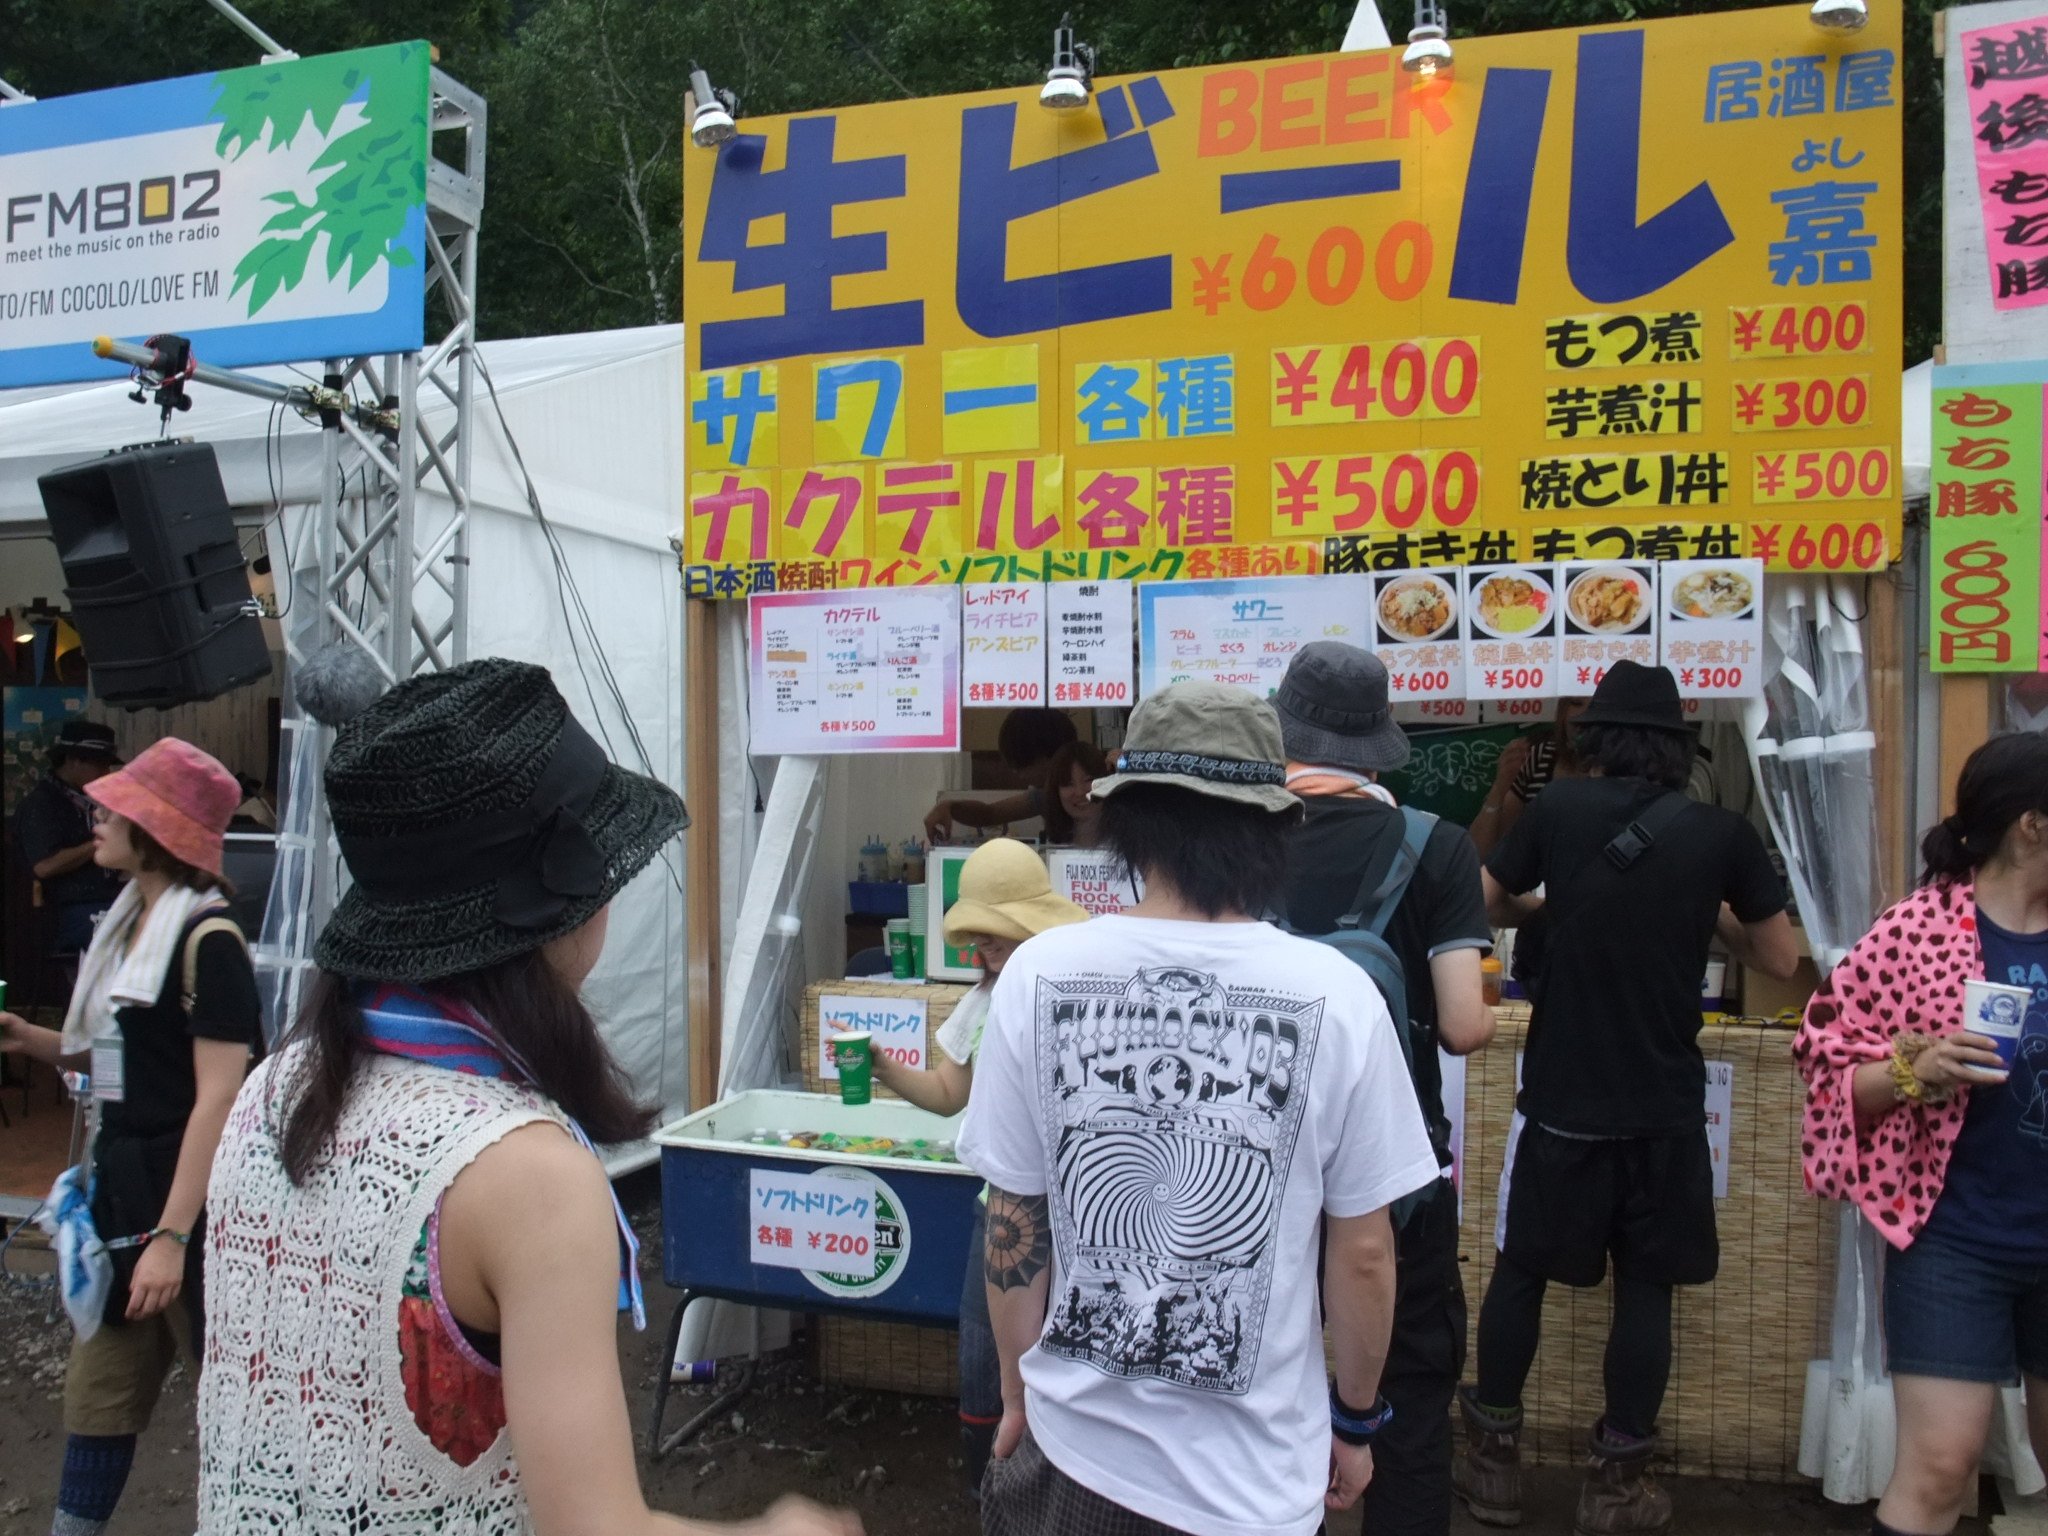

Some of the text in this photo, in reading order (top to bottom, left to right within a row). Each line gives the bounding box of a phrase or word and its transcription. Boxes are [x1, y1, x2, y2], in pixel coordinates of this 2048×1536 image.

[1703, 48, 1895, 123] 居酒屋
[1197, 54, 1455, 158] BEER
[1791, 136, 1866, 173] よし
[7, 169, 221, 243] FM802
[697, 29, 1735, 370] 生ビール
[6, 223, 220, 264] meet the music on the radio
[1768, 181, 1878, 287] 嘉
[1191, 220, 1434, 316] ¥600
[61, 274, 185, 314] COCOLO/LOVE
[193, 270, 219, 299] FM
[1545, 303, 1866, 368] もつ煮 ¥400
[1274, 339, 1478, 420] ¥400
[1545, 377, 1868, 439] 芋煮汁 ¥300
[1274, 451, 1478, 532] ¥500
[1520, 449, 1889, 510] 焼とり丼 ¥500
[1750, 522, 1883, 571] ¥600
[824, 607, 880, 624] カクテル
[966, 589, 1029, 606] レッドアイ
[1232, 600, 1284, 618] サワー
[1263, 642, 1297, 653] オレンジ
[1392, 671, 1449, 691] ¥600
[1484, 668, 1544, 689] ¥500
[1680, 667, 1742, 688] ¥300
[1071, 881, 1107, 892] FUJI
[1081, 865, 1097, 880] ROCK
[1072, 892, 1121, 904] ROCK
[756, 1187, 869, 1219] ソフトドリンク
[758, 1225, 793, 1248] 各種
[808, 1231, 869, 1256] ¥200
[1160, 1365, 1171, 1378] TO
